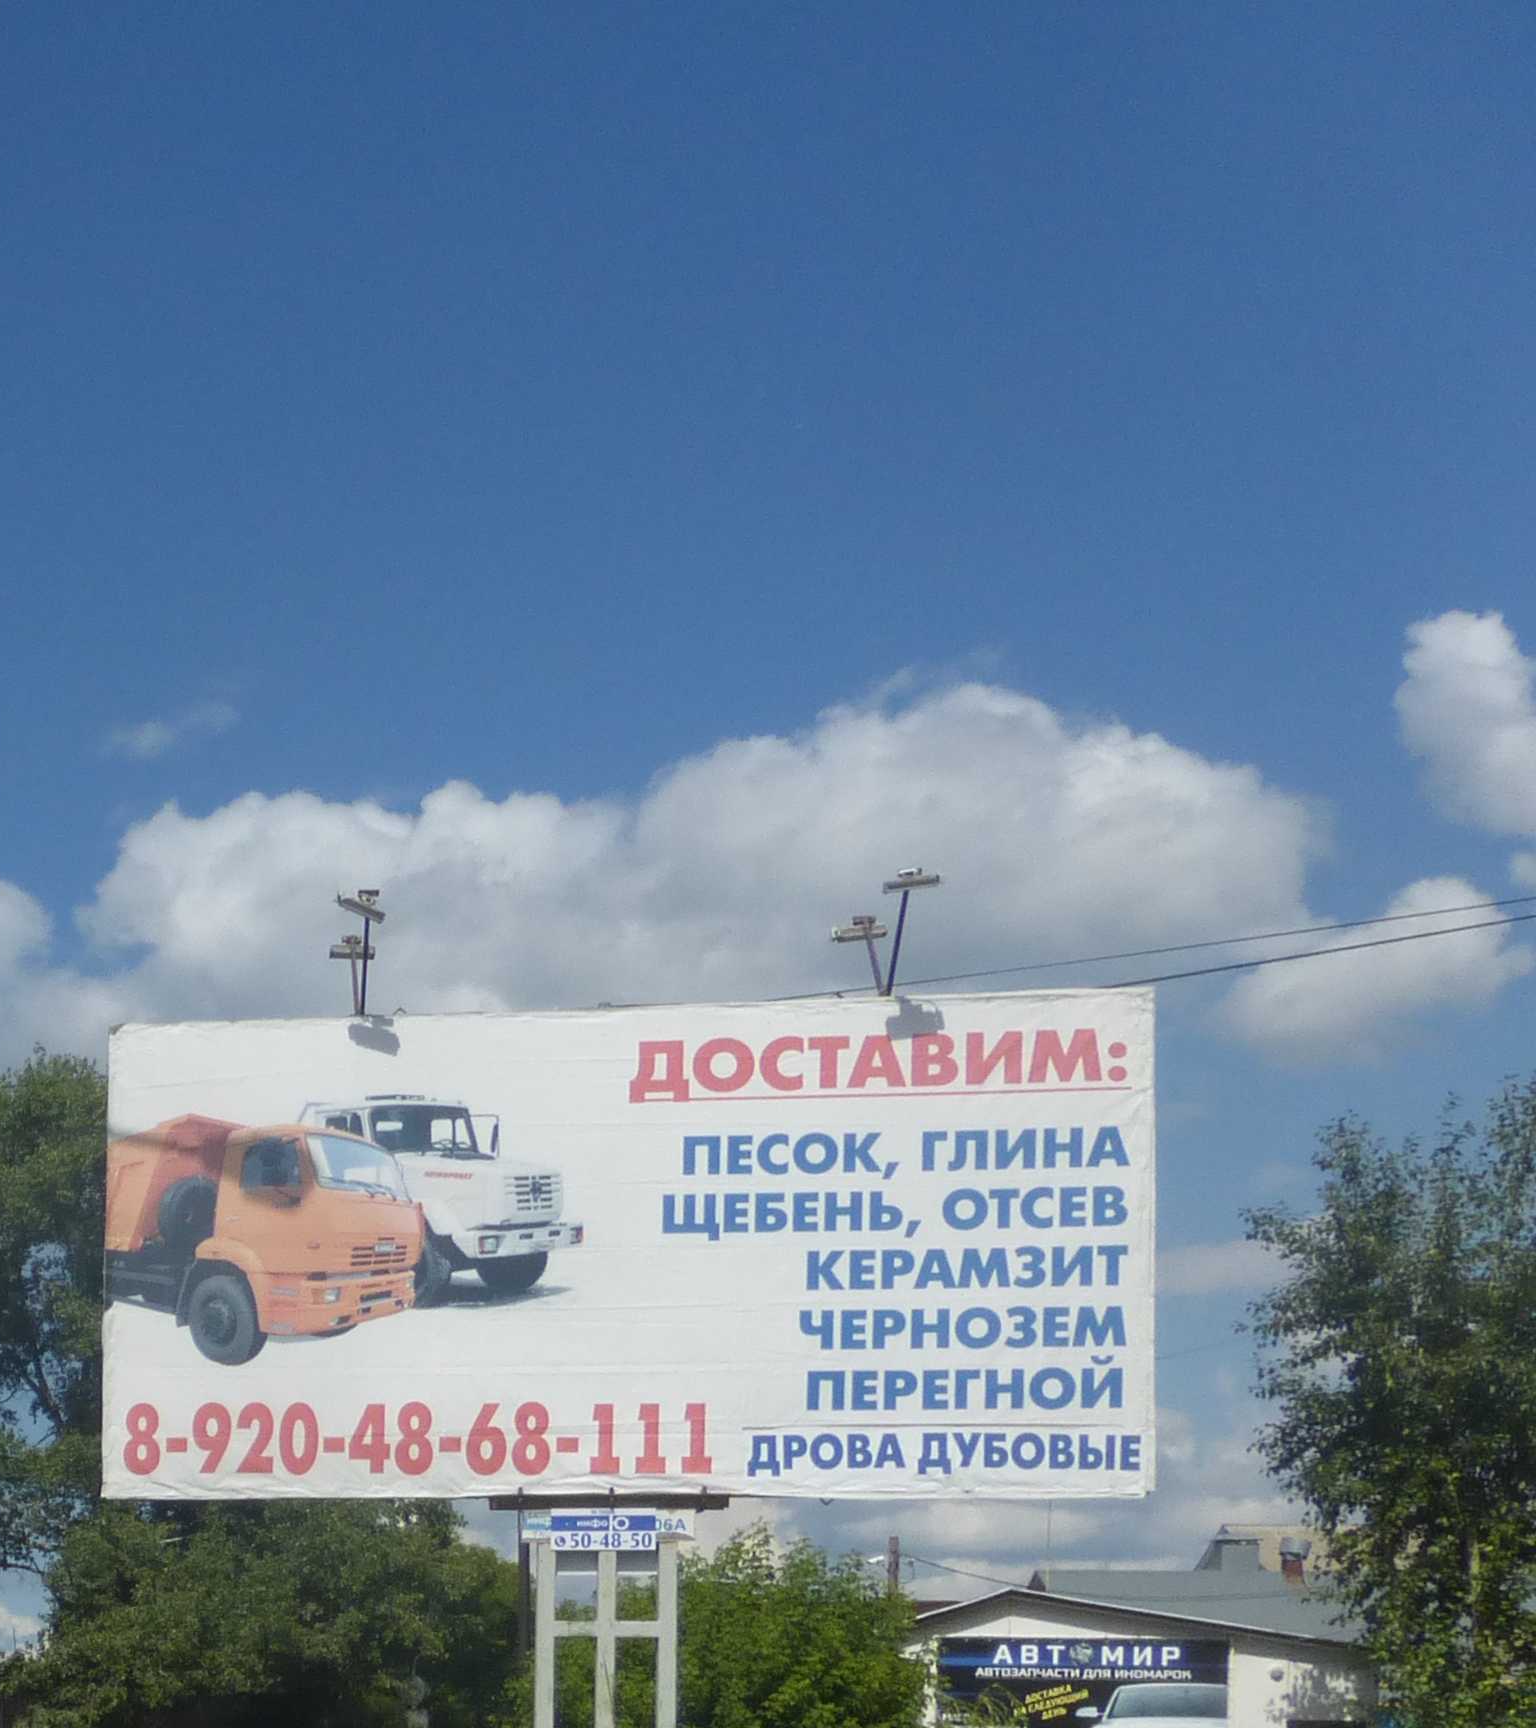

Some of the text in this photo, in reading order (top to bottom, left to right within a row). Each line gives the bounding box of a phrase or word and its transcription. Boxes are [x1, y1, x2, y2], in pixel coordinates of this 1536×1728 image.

[629, 1028, 1128, 1103] ДОСТАВИМ:
[682, 1126, 1130, 1180] ПЕСОК, ГЛИНА
[661, 1185, 1128, 1241] ЩЕБЕНЬ, ОТСЕВ
[805, 1244, 1128, 1292] КЕРАМЗИТ
[799, 1305, 1127, 1350] ЧЕРНОЗЕМ
[806, 1355, 1123, 1411] ПЕРЕГНОЙ
[122, 1401, 712, 1475] 8-920-48-68-111
[747, 1432, 1142, 1477] ДРОВА ДУБОВЫЕ
[570, 1532, 652, 1549] 50-48-50
[975, 1666, 1192, 1681] АВТОЗАПЧАСТИ ДЛЯ ИНОМАРОК
